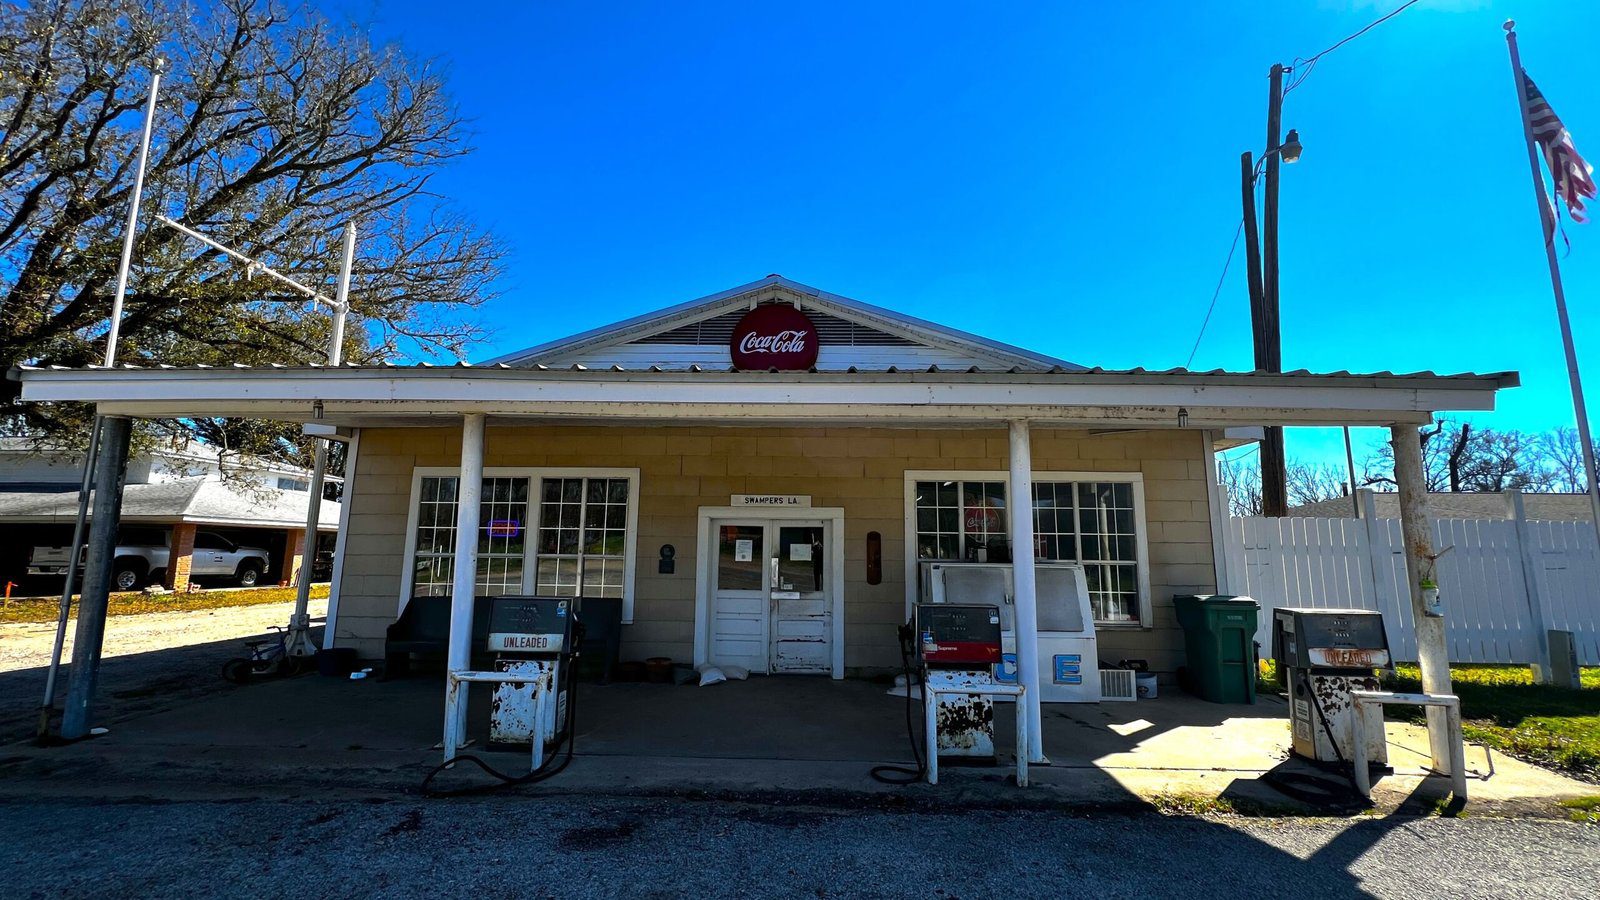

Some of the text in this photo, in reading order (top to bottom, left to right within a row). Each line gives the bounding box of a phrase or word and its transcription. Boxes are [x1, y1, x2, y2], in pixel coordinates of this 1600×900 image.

[740, 330, 808, 354] Coca-Cola
[744, 496, 784, 505] SWAMPERS
[503, 636, 548, 649] UNLEADED
[1325, 649, 1372, 665] UNLEADED
[992, 653, 1082, 684] CE
